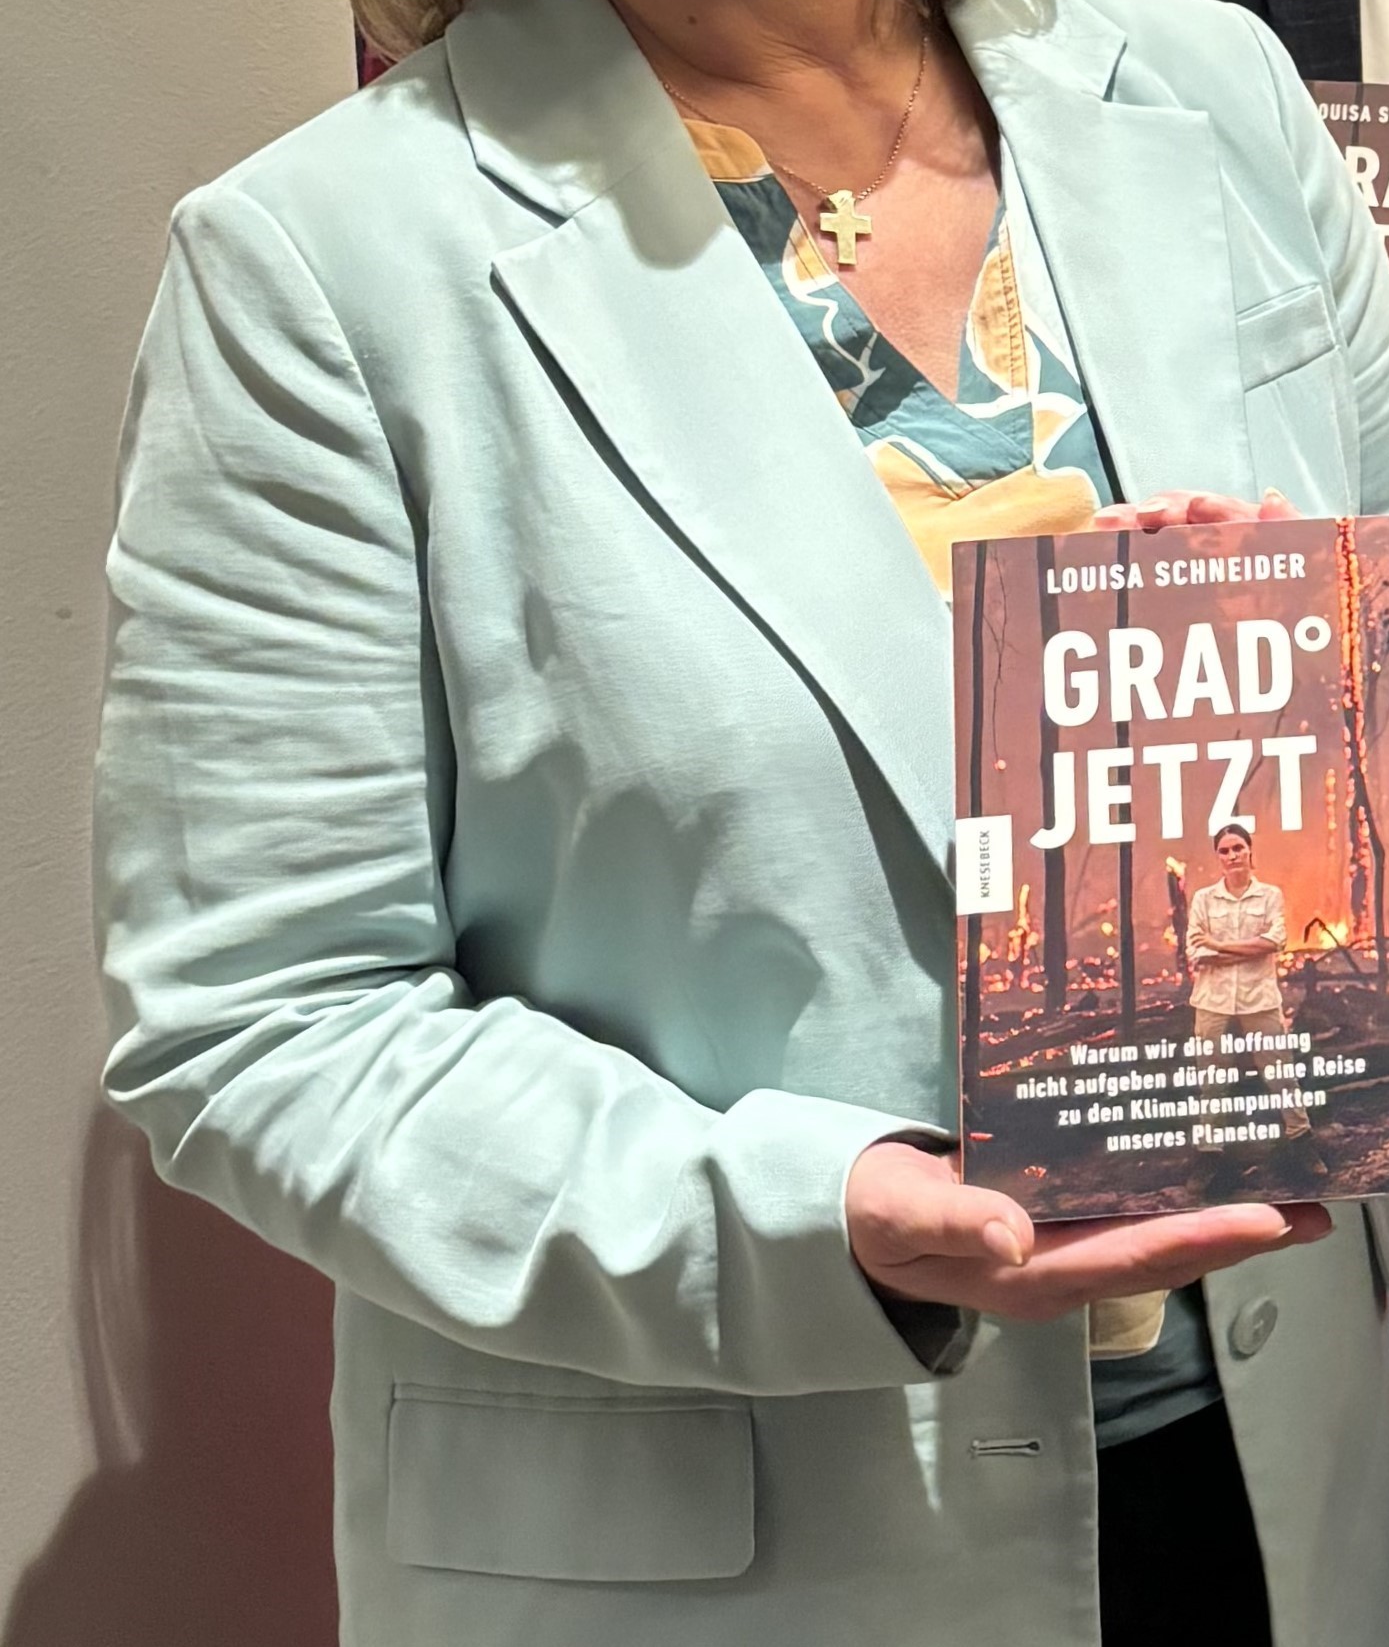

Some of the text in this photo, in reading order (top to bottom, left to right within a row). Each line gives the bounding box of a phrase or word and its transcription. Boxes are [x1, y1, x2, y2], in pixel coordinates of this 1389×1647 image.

[1317, 103, 1371, 122] OUISA
[1047, 553, 1306, 594] LOUISA SCHNEIDER
[1043, 615, 1332, 727] GRAD°
[1029, 735, 1317, 849] JETZT
[980, 830, 991, 898] KNESEBECK
[1070, 1031, 1311, 1066] Warum wir die Hoffnung
[1016, 1076, 1068, 1100] nicht
[1073, 1070, 1167, 1097] aufgeben
[1172, 1064, 1239, 1088] dürfen
[1264, 1059, 1307, 1080] eine
[1312, 1054, 1366, 1077] Reise
[1058, 1088, 1326, 1126] zu den Klimabrennpunkten
[1107, 1121, 1280, 1152] unseres Planeten
